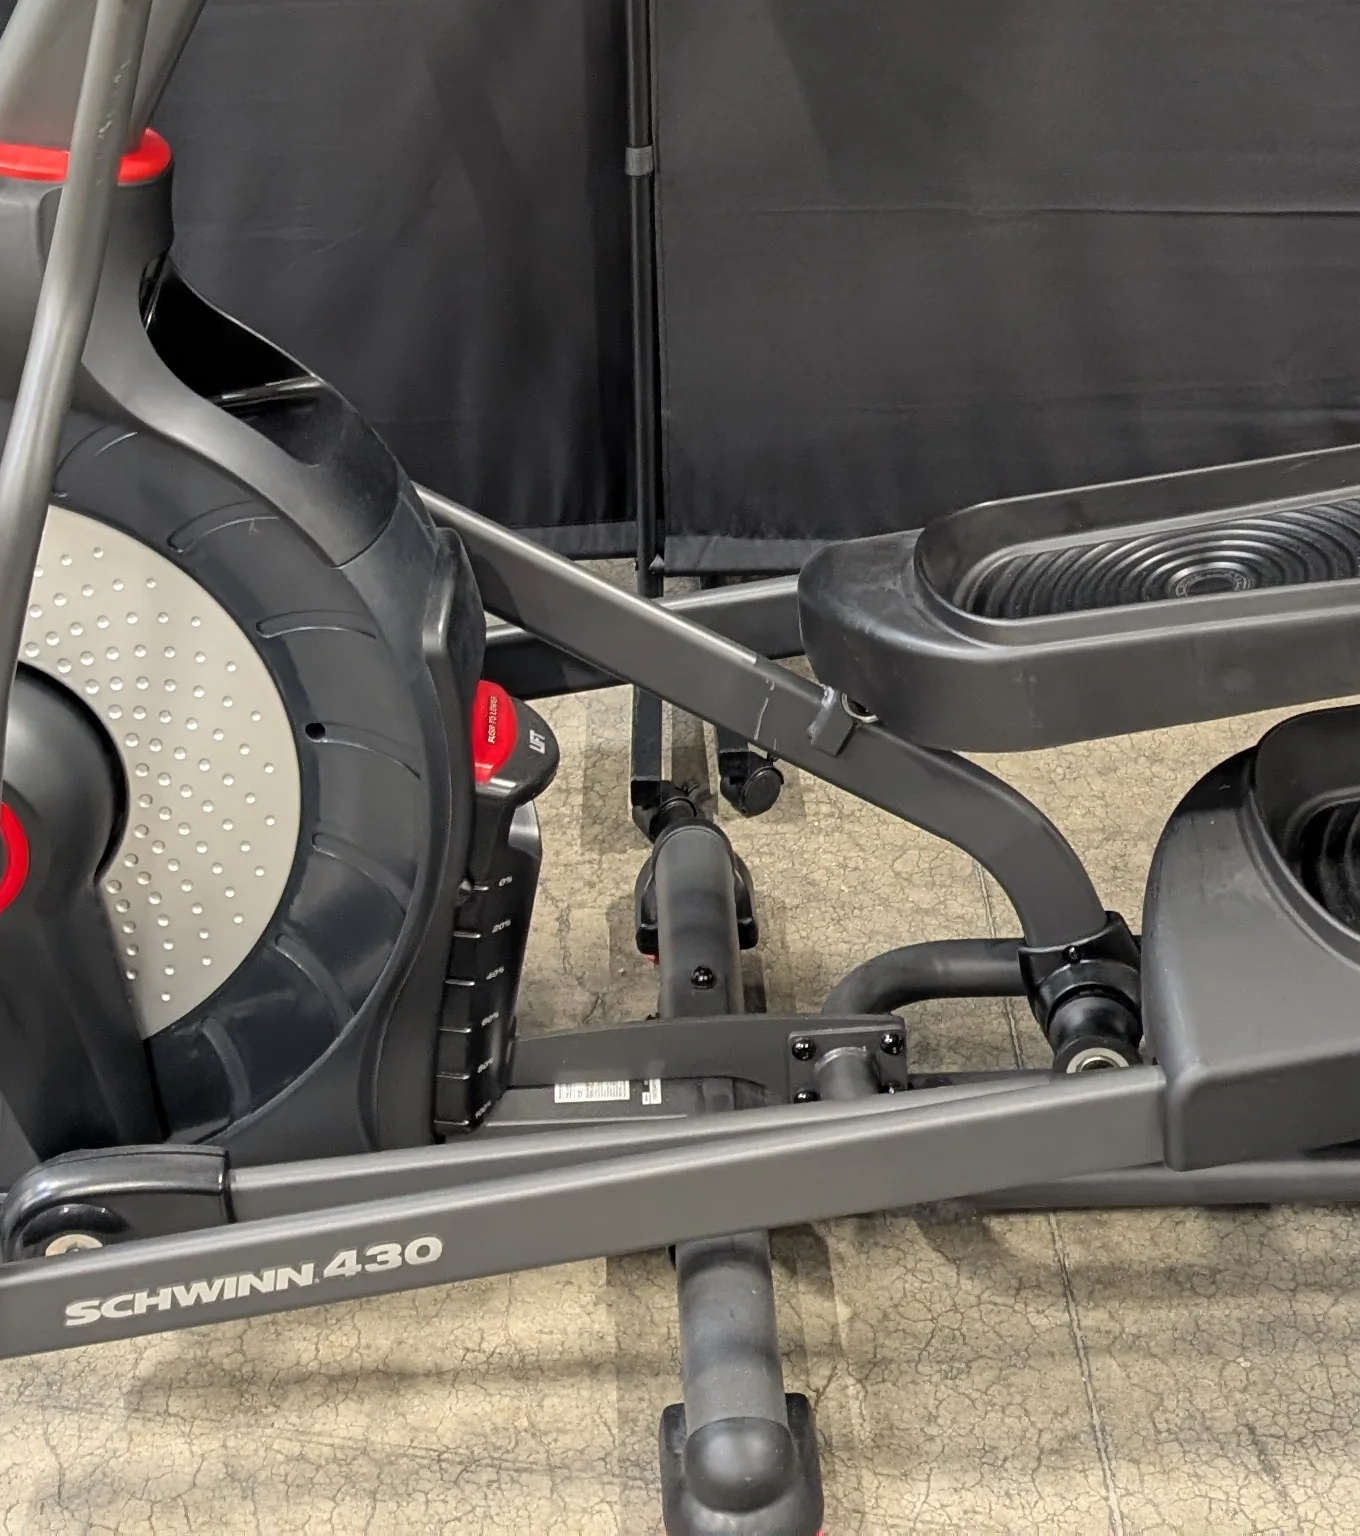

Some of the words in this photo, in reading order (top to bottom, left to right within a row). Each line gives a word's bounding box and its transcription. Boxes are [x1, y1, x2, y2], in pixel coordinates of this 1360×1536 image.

[529, 729, 546, 754] LIFT
[65, 1262, 315, 1327] SCHWINN
[322, 1235, 443, 1279] 430
